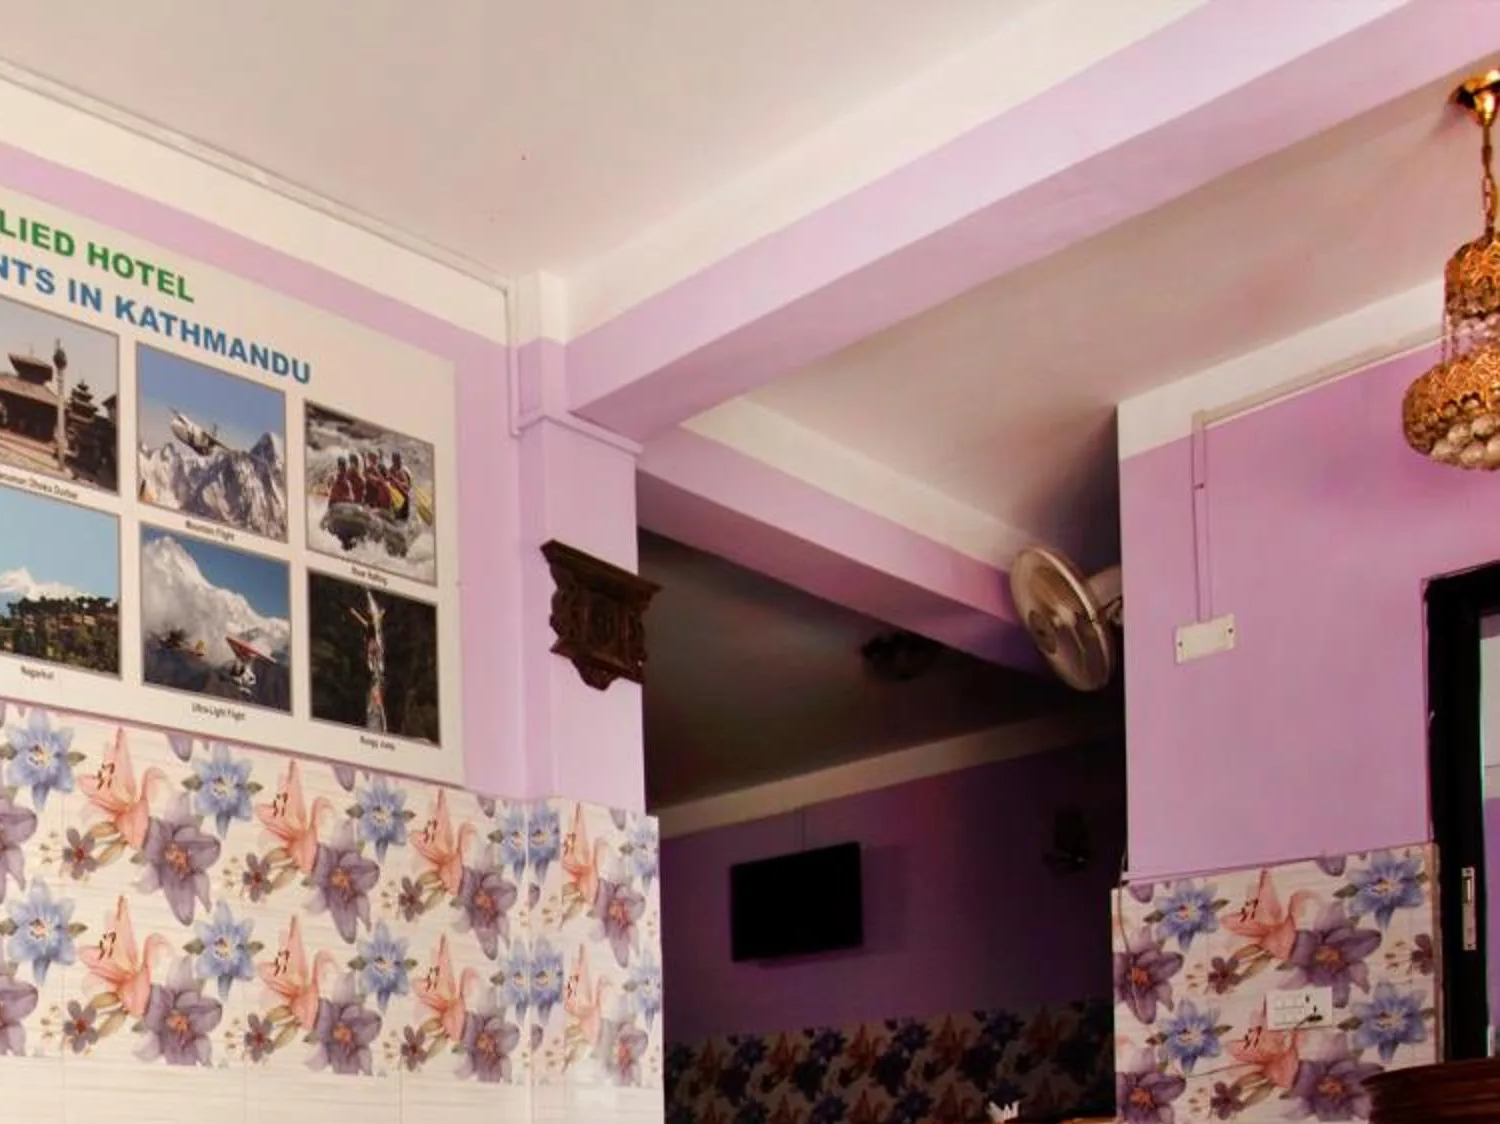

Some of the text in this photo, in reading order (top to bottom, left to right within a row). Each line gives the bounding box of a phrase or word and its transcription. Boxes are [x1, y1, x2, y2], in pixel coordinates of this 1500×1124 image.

[87, 242, 195, 303] HOTEL
[69, 278, 102, 312] IN
[115, 296, 312, 384] KATHMANDU
